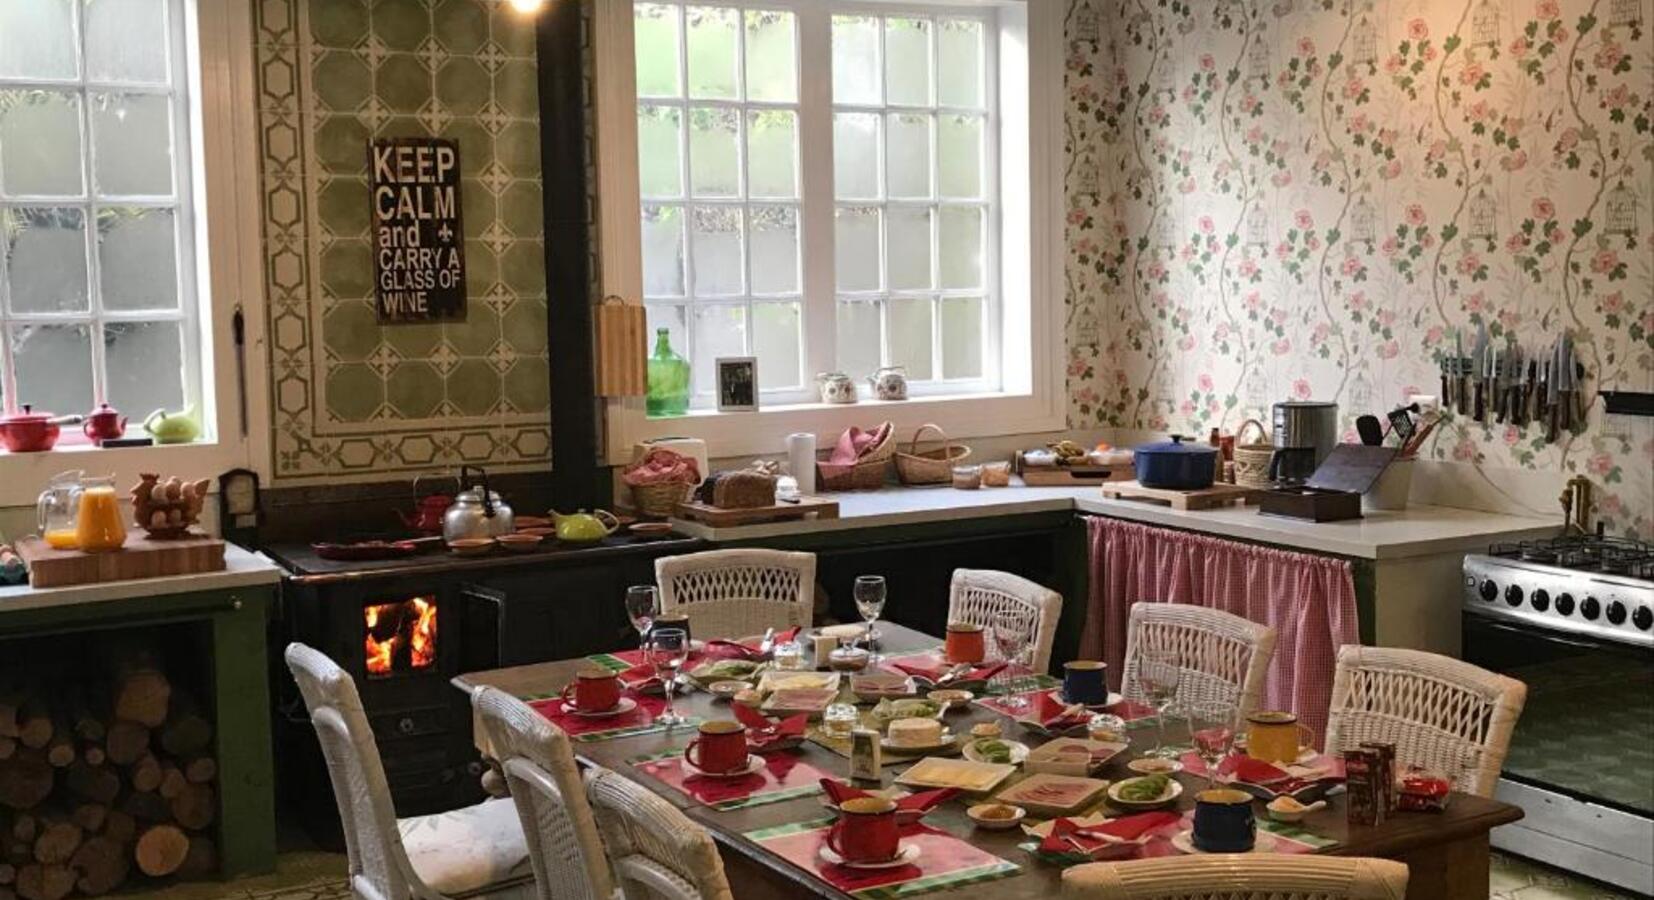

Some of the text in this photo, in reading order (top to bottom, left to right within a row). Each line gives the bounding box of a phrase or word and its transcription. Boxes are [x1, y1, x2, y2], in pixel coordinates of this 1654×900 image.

[373, 146, 455, 183] KEEP
[375, 185, 455, 220] CALM
[379, 219, 420, 248] and
[380, 247, 460, 271] CARRY A
[381, 269, 461, 290] GLASS OF
[382, 292, 428, 313] WINE
